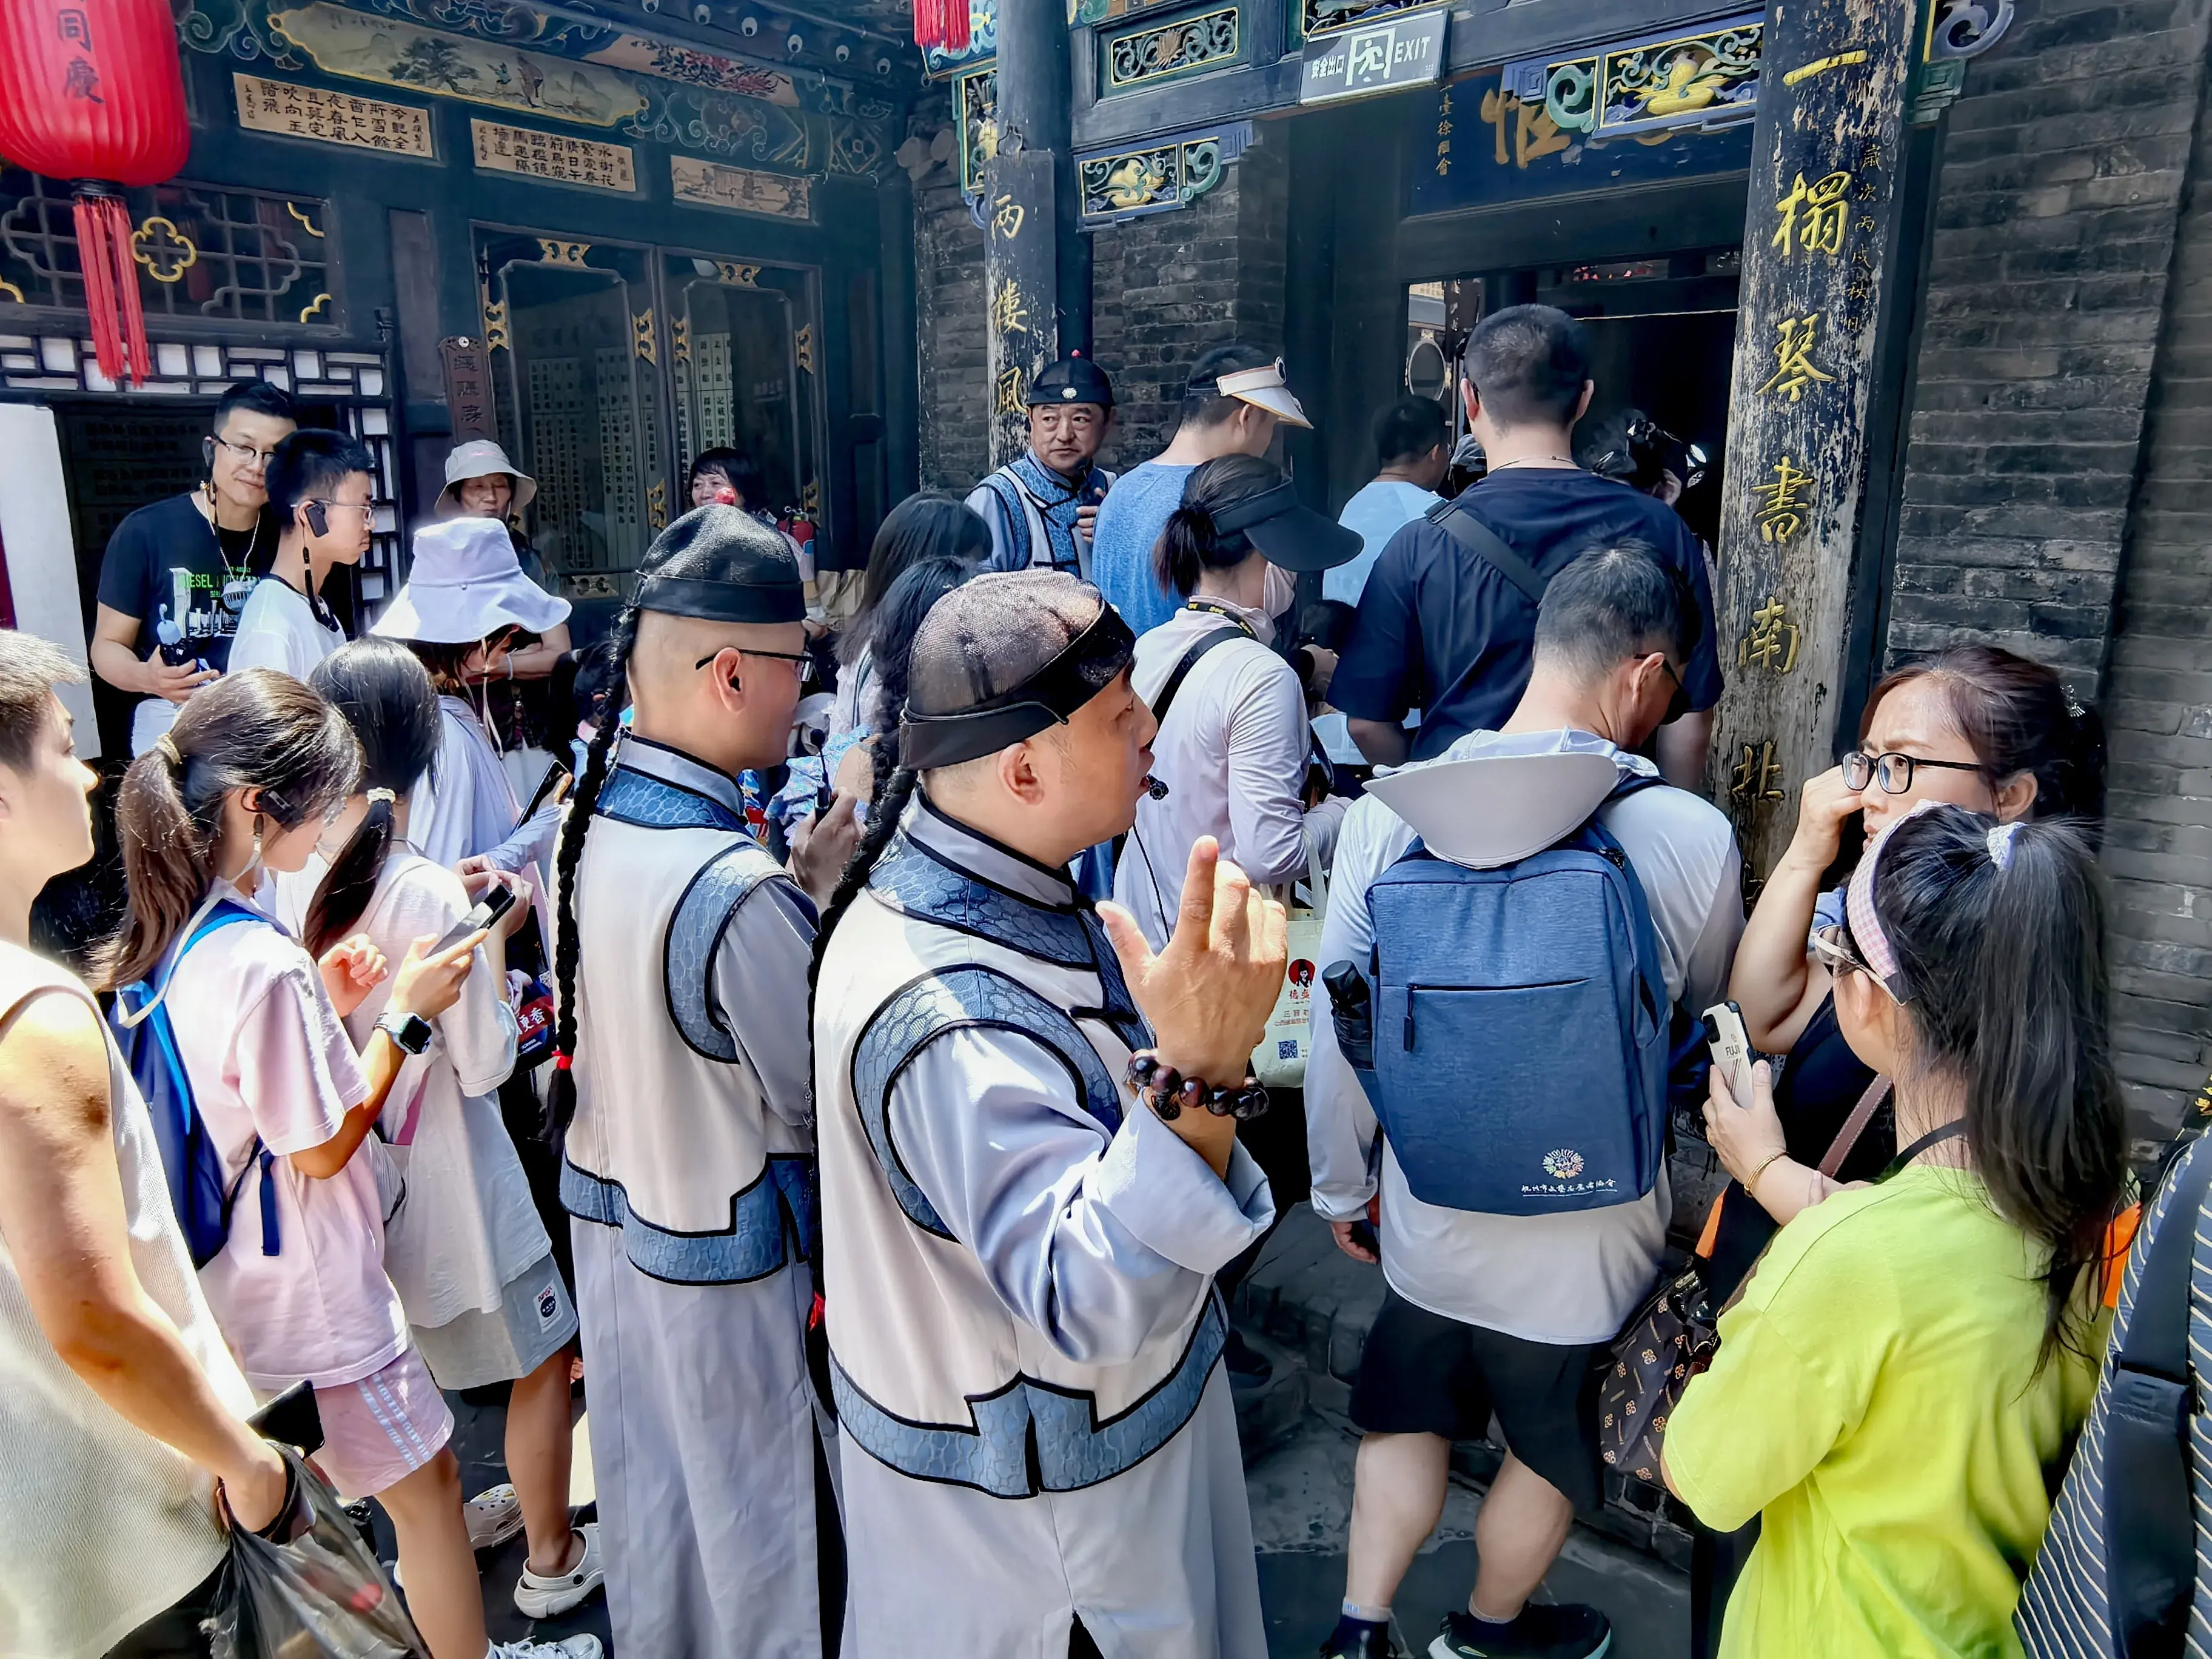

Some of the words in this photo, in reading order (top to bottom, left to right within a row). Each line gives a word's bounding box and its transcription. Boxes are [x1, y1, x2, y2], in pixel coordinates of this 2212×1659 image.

[1394, 36, 1431, 63] EXIT
[1311, 53, 1346, 79] 安全出口
[1725, 1044, 1741, 1056] FUJI
